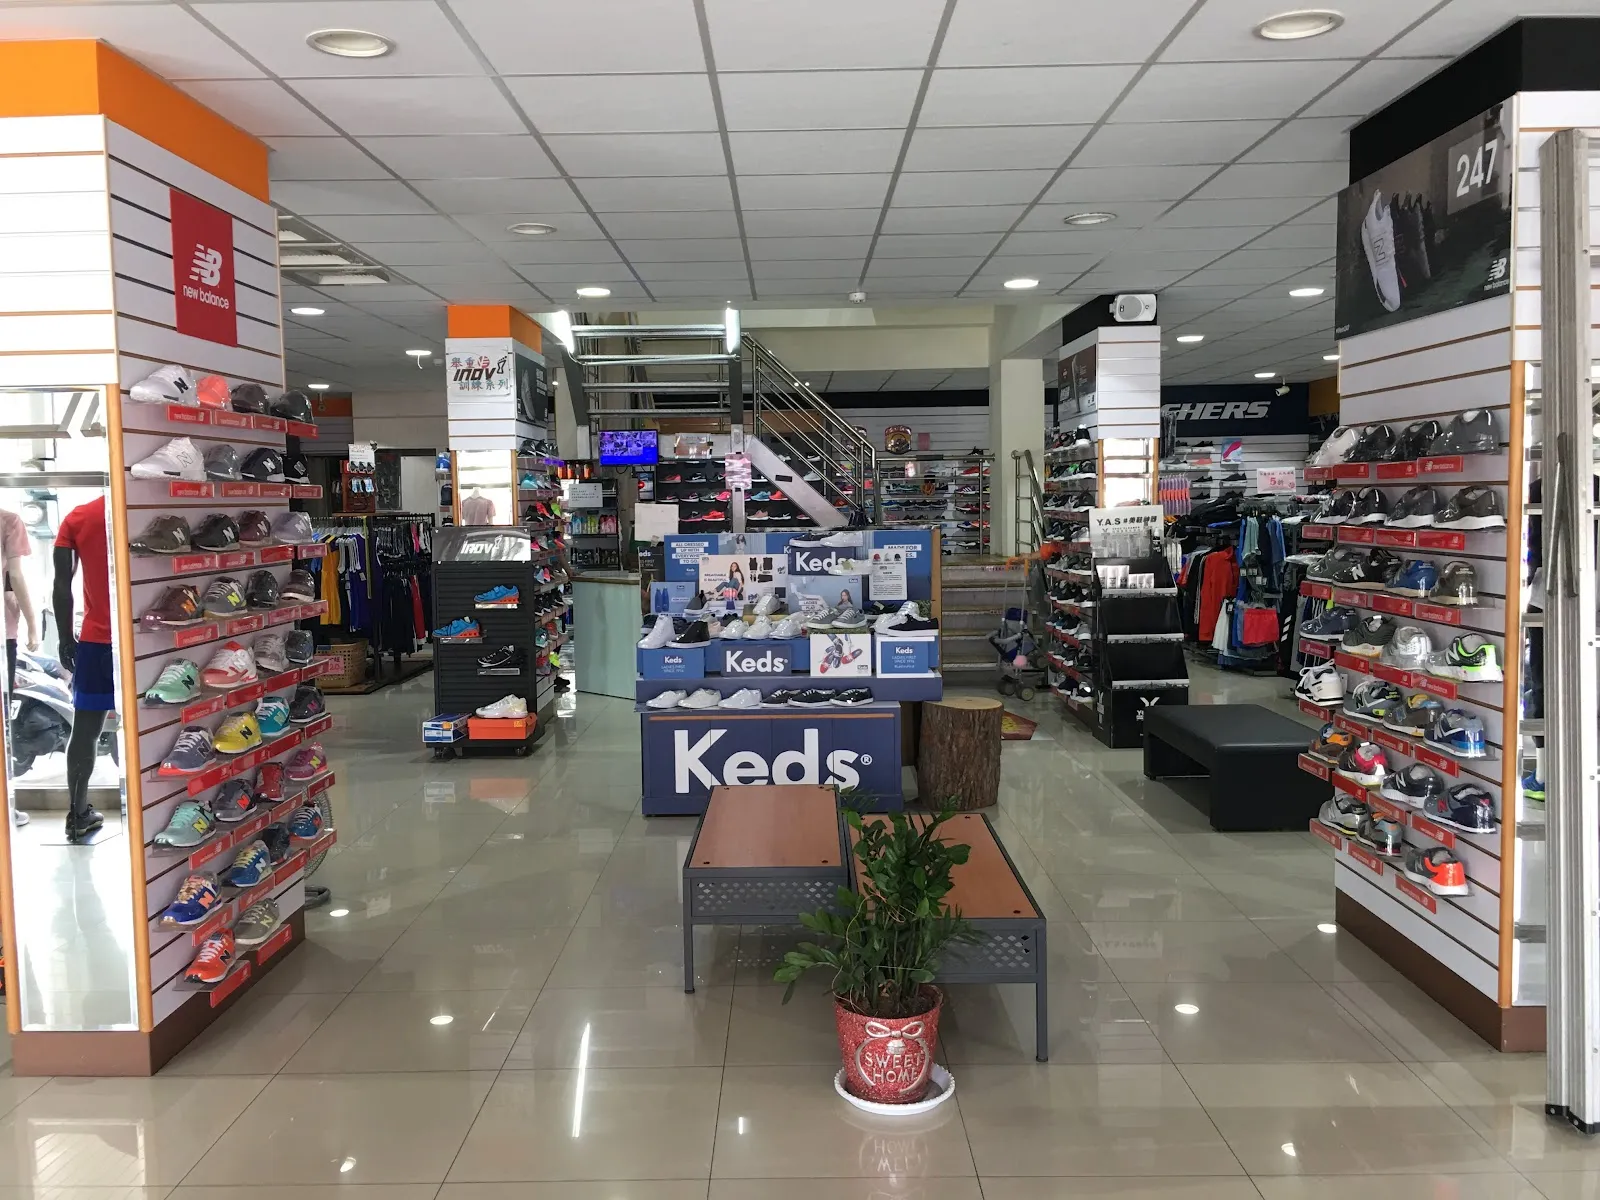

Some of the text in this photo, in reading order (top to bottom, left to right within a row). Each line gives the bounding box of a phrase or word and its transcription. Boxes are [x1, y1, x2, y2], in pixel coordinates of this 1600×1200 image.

[1456, 139, 1498, 197] 247
[182, 284, 230, 310] new balance
[864, 1052, 924, 1068] SWEET
[872, 1069, 919, 1084] HOME
